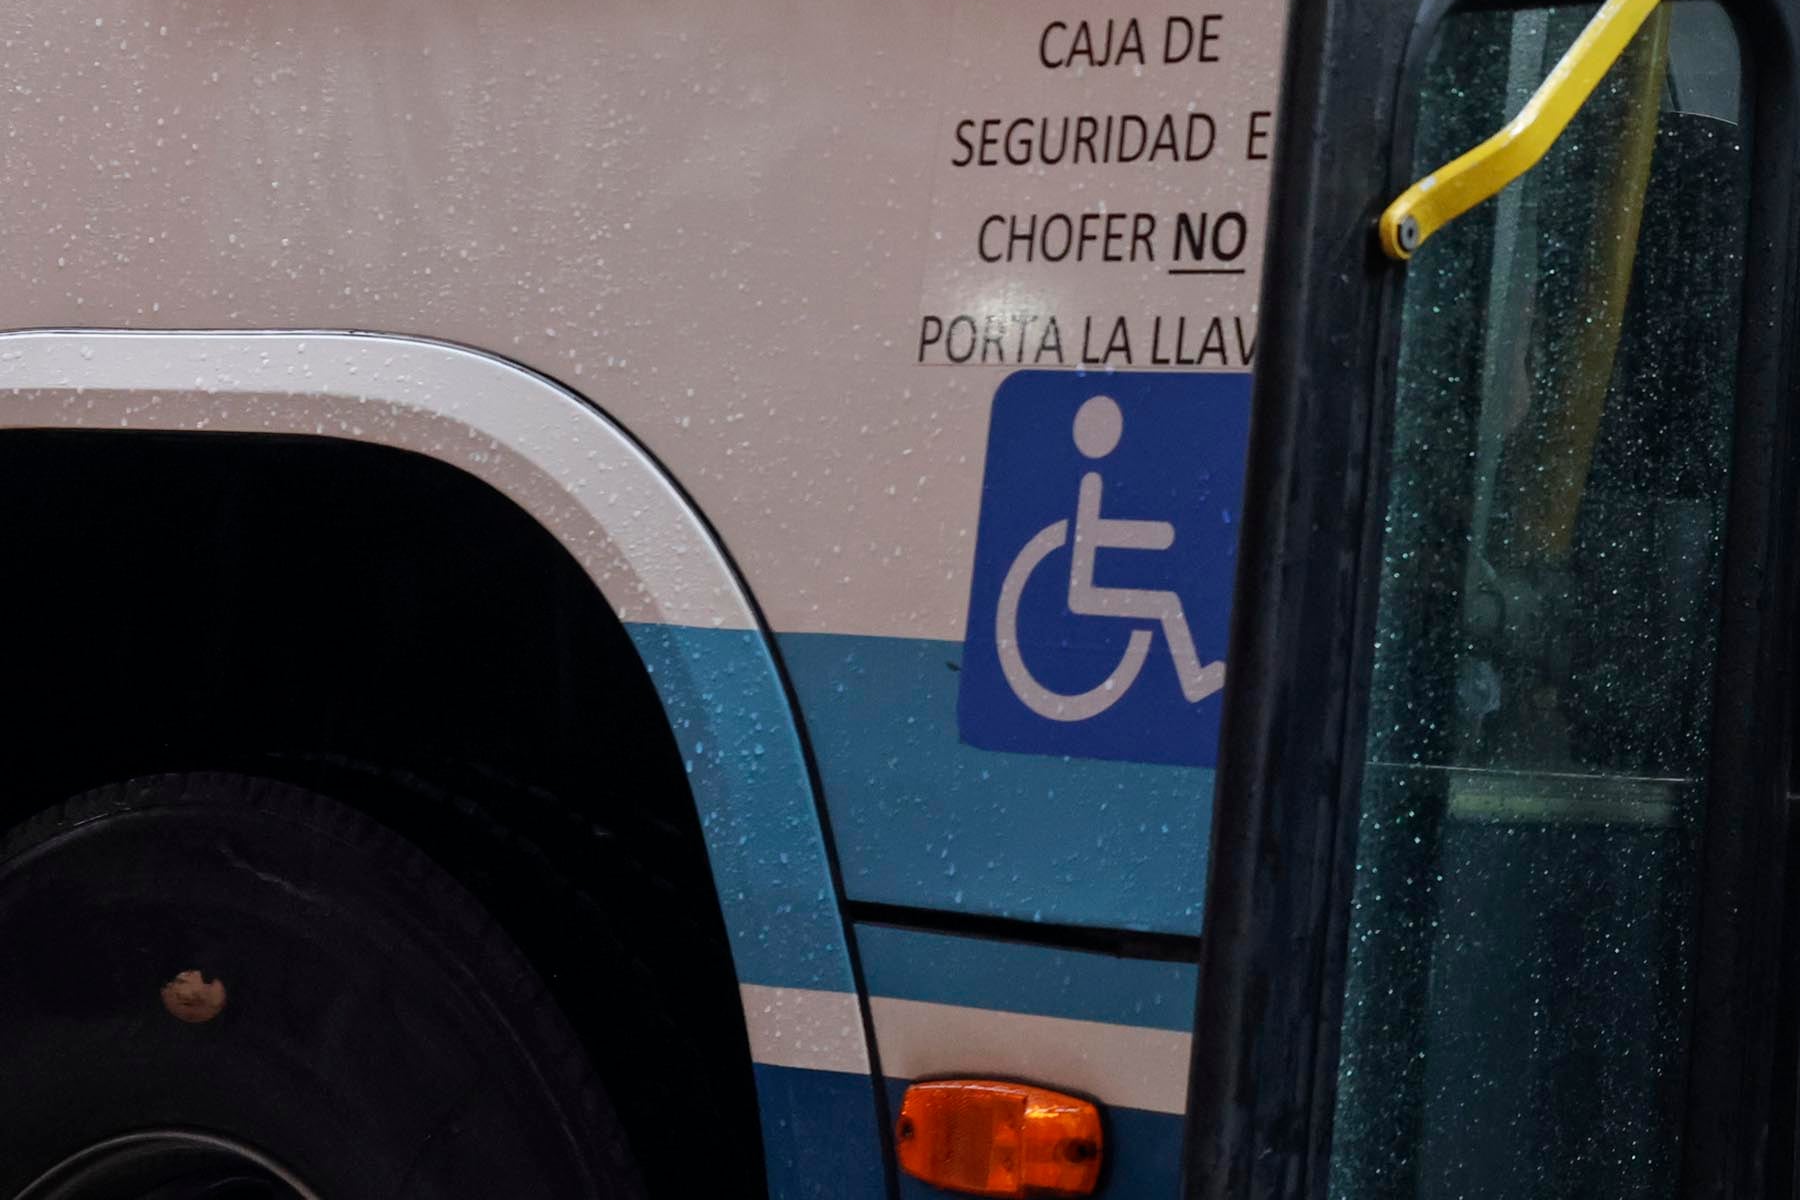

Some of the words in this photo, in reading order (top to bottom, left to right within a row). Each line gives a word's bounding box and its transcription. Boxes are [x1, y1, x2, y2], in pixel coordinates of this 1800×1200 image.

[1039, 18, 1145, 68] CAJA
[1163, 14, 1223, 64] DE
[952, 111, 1216, 167] SEGURIDAD
[978, 212, 1155, 263] CHOFER
[1171, 211, 1247, 268] NO
[918, 314, 1064, 364] PORTA
[1082, 315, 1132, 365] LA
[1151, 316, 1257, 366] LLAV
